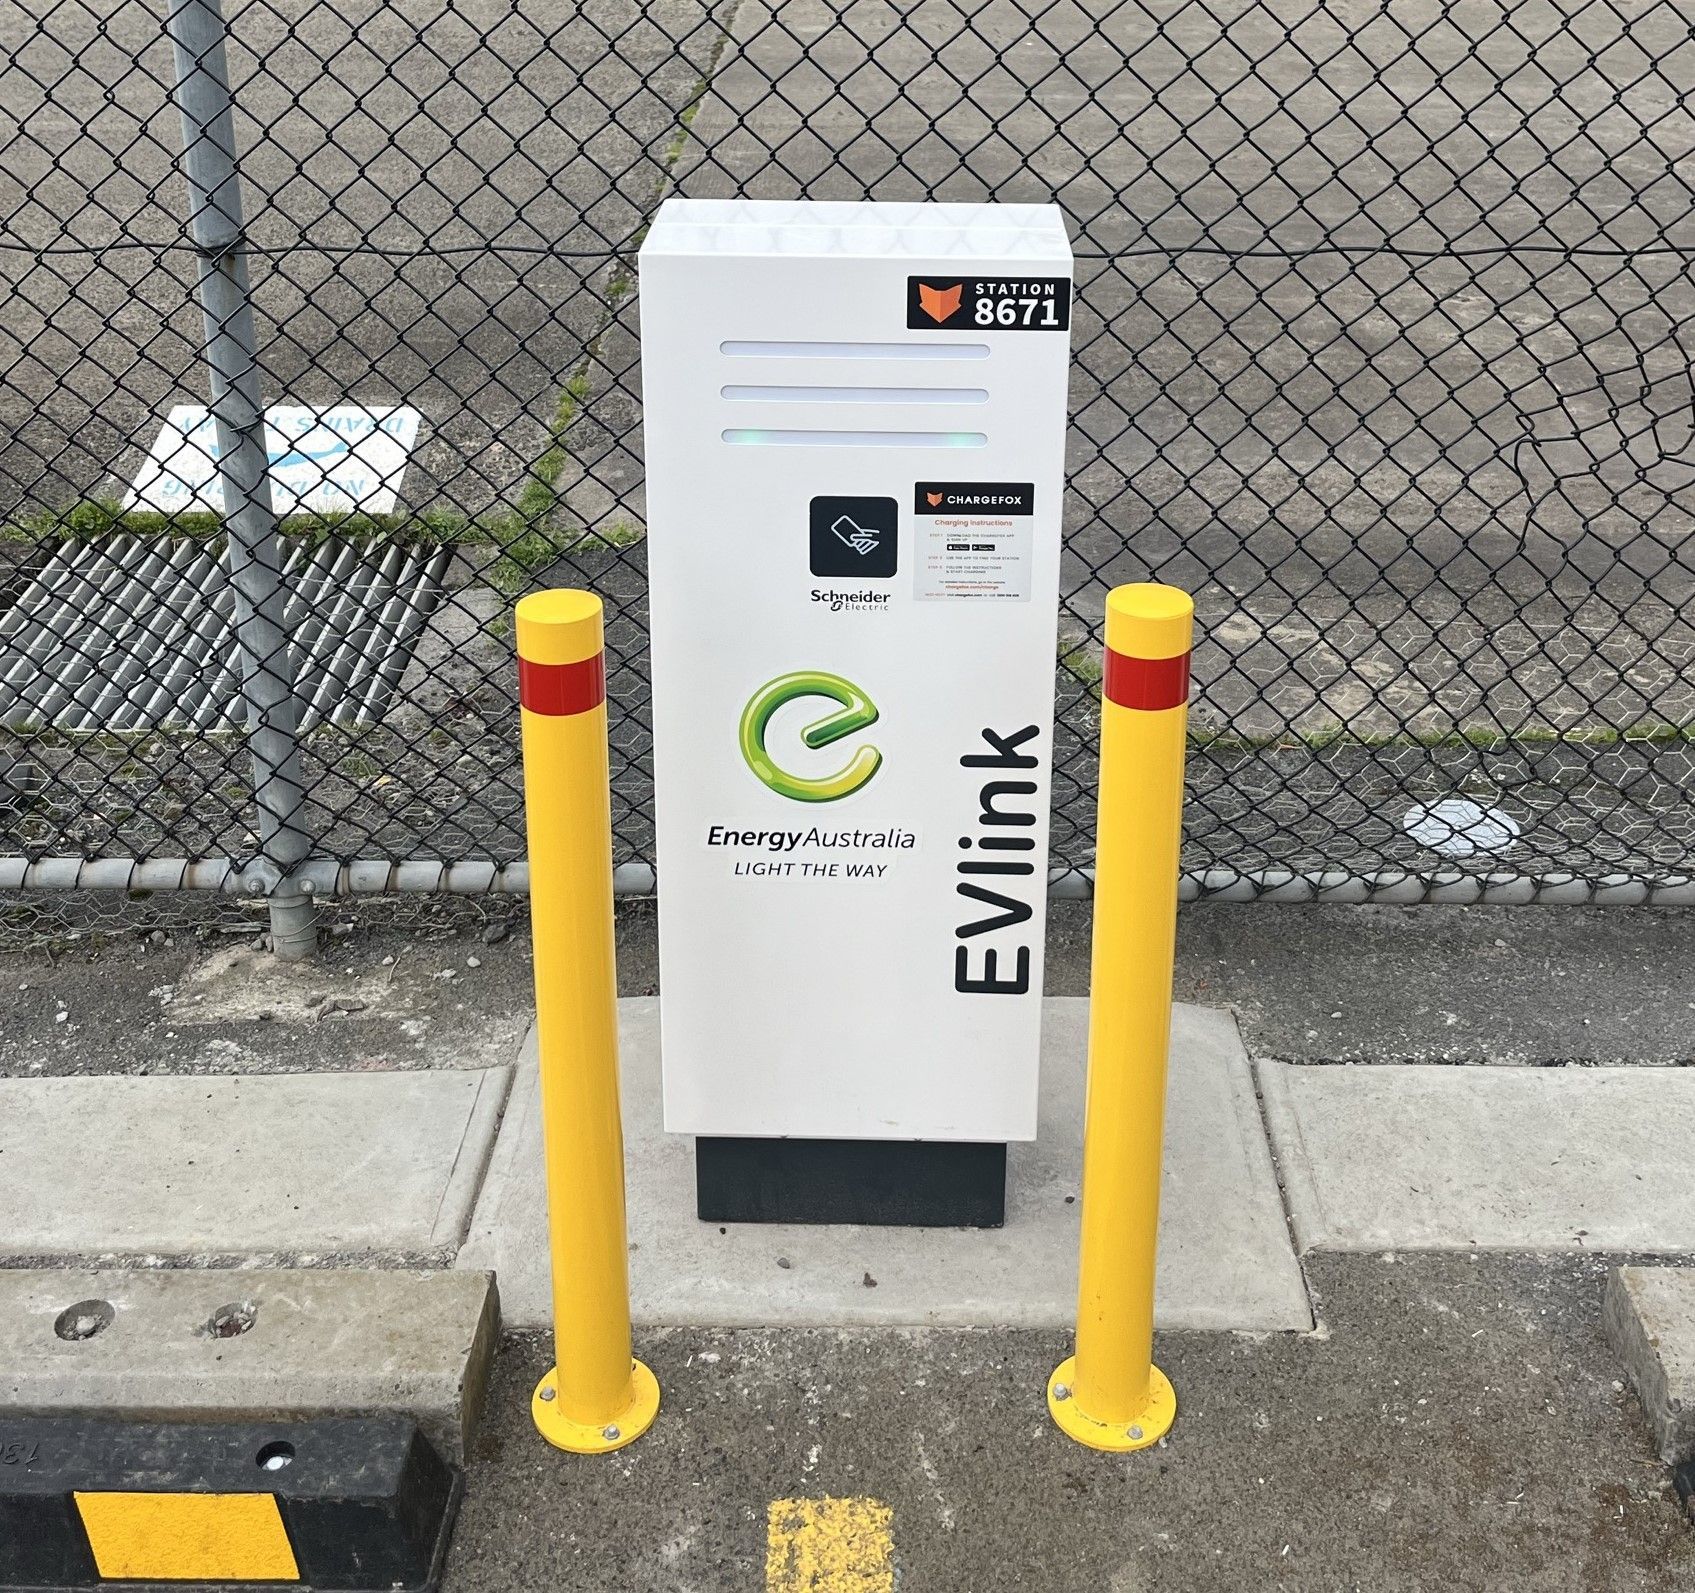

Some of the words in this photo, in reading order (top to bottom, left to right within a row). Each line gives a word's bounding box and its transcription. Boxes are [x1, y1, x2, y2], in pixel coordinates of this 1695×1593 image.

[975, 283, 1055, 295] STATION
[974, 297, 1059, 326] 8671
[322, 479, 365, 497] NO
[947, 495, 1022, 505] CHARGEFOX
[934, 519, 969, 527] Charging
[810, 589, 891, 603] Schneider
[845, 602, 889, 611] Electric
[707, 825, 916, 852] EnergyAustralia
[954, 724, 1041, 995] EVlink
[734, 862, 796, 876] LIGHT
[801, 863, 839, 877] THE
[846, 864, 888, 878] WAY
